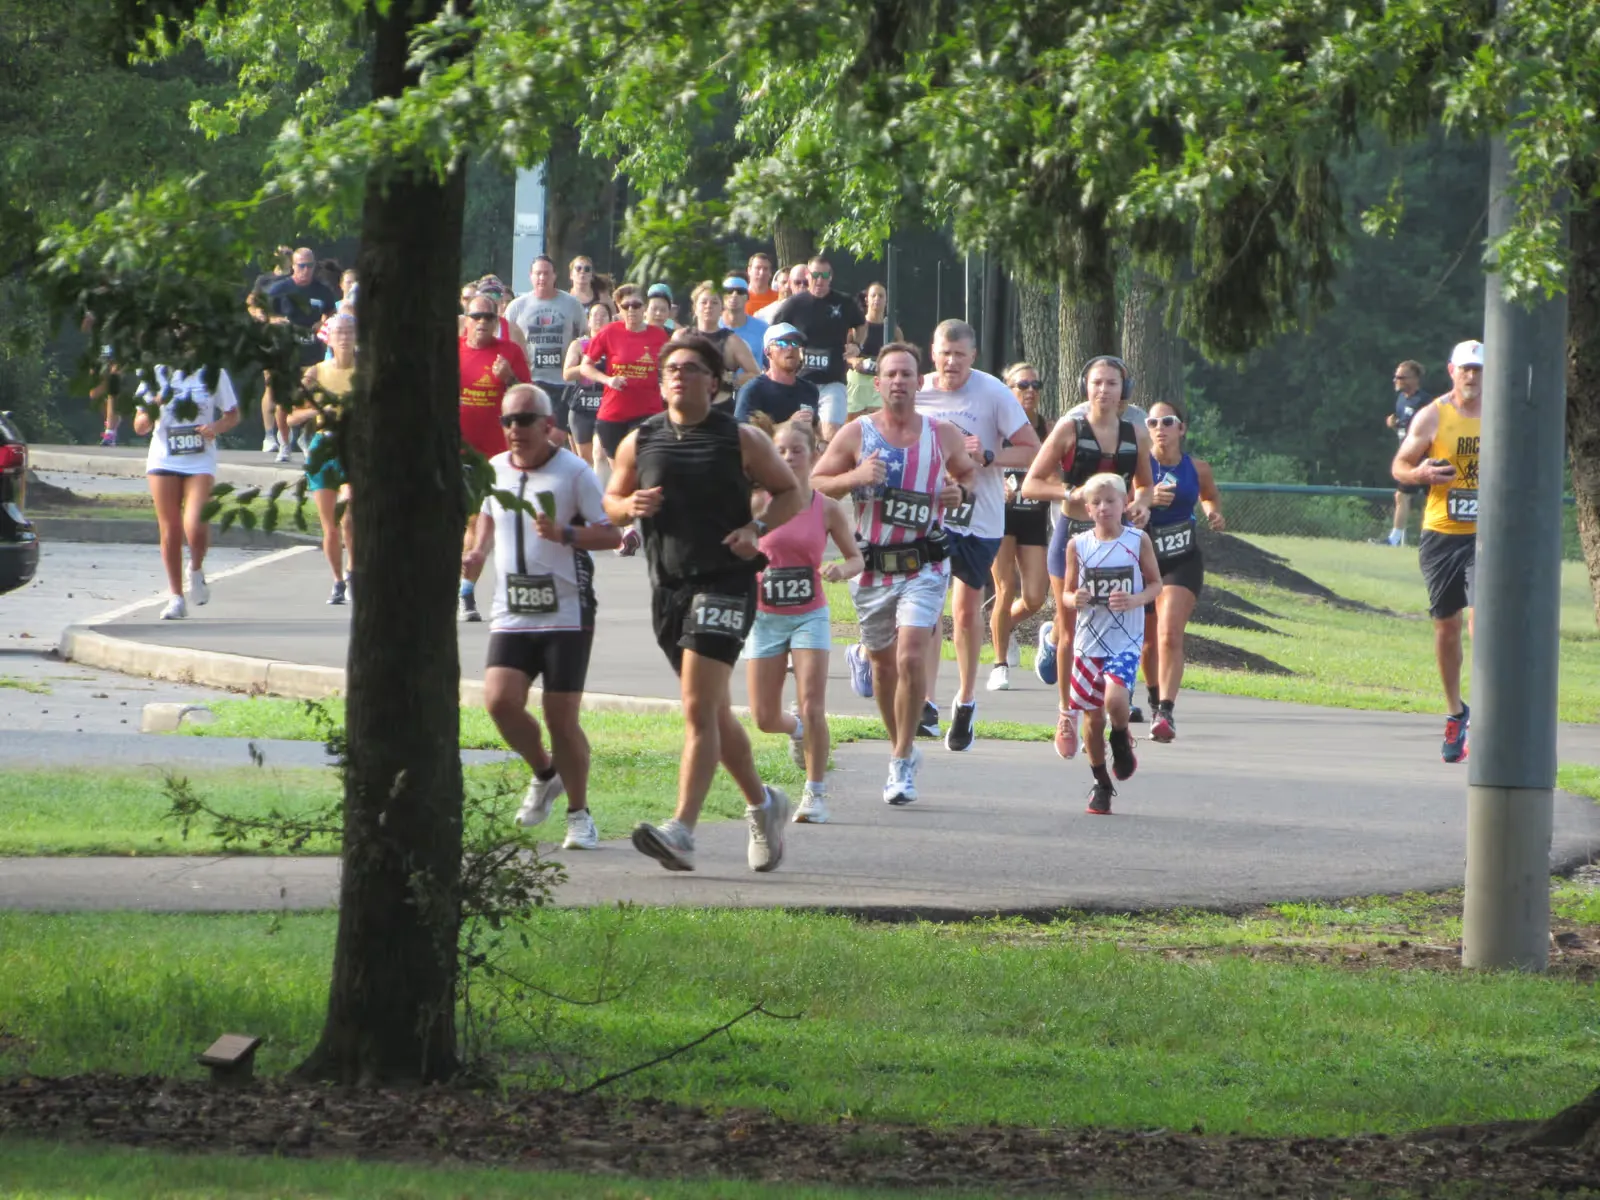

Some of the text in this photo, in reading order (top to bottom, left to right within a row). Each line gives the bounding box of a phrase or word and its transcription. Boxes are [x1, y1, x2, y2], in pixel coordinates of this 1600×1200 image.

[535, 354, 561, 365] 1303
[804, 354, 829, 367] 1216
[580, 396, 603, 407] 128
[885, 498, 930, 523] 1219
[1448, 498, 1478, 515] 122
[1154, 529, 1192, 552] 1237
[507, 586, 554, 606] 1286
[763, 578, 812, 599] 1123
[1086, 578, 1132, 597] 1220
[695, 606, 744, 630] 1245
